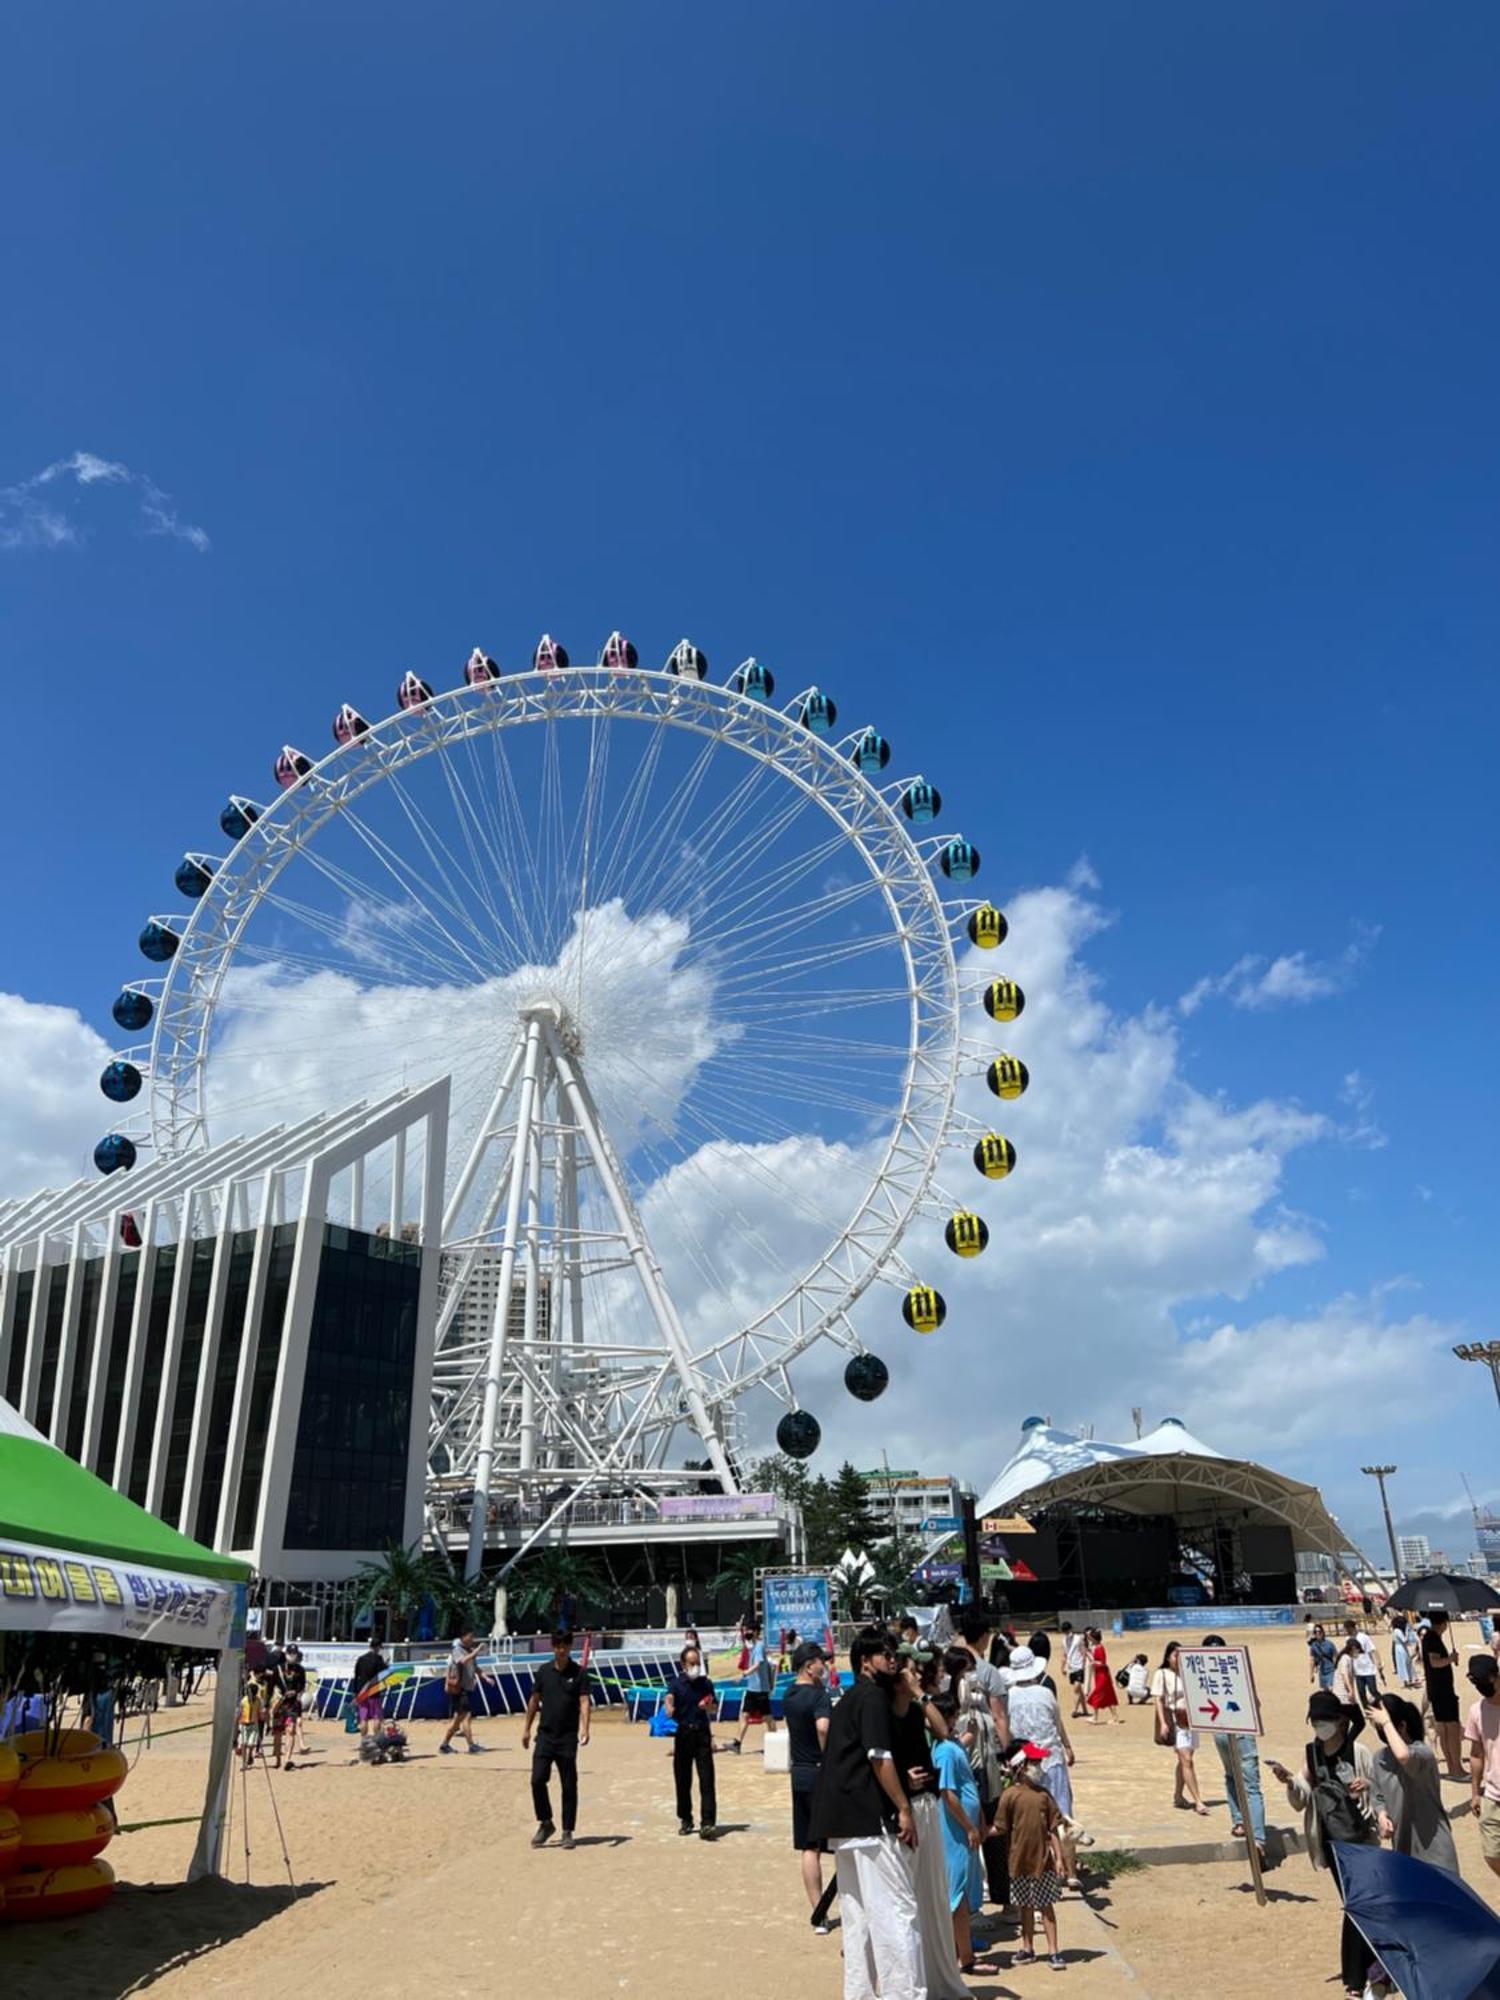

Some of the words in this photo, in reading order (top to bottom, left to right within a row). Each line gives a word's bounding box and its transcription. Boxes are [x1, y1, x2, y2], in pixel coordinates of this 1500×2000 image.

[1185, 1655, 1206, 1674] 개인
[1208, 1655, 1239, 1674] 그늘막
[1198, 1676, 1219, 1695] 치는
[1221, 1676, 1233, 1695] 곳
